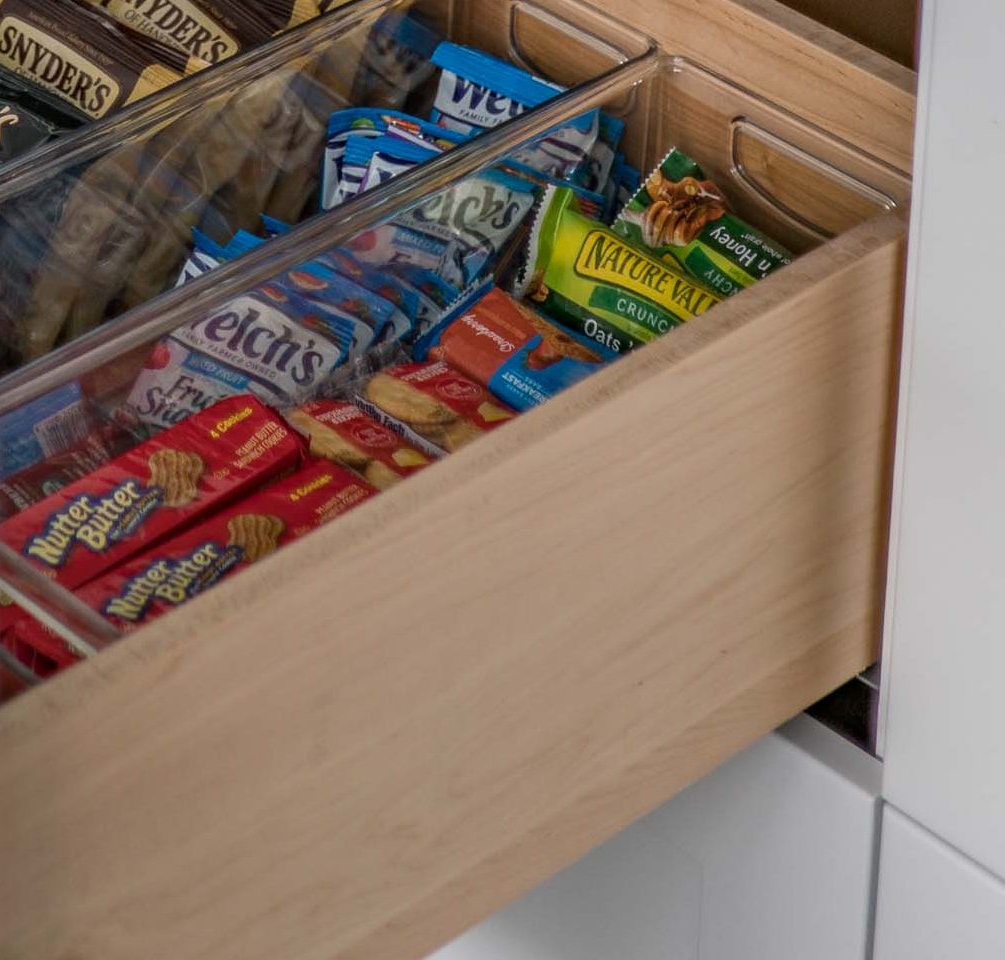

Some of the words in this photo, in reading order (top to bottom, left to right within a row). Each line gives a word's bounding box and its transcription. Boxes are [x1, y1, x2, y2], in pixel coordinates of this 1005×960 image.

[583, 233, 675, 295] NATURE
[709, 225, 758, 268] Honey
[189, 306, 325, 387] elch's
[583, 318, 622, 353] Oats
[616, 297, 676, 334] CRUNC
[28, 495, 94, 566] Nutter
[76, 481, 141, 552] Butter
[105, 559, 172, 620] Nutter
[155, 543, 219, 605] Butter
